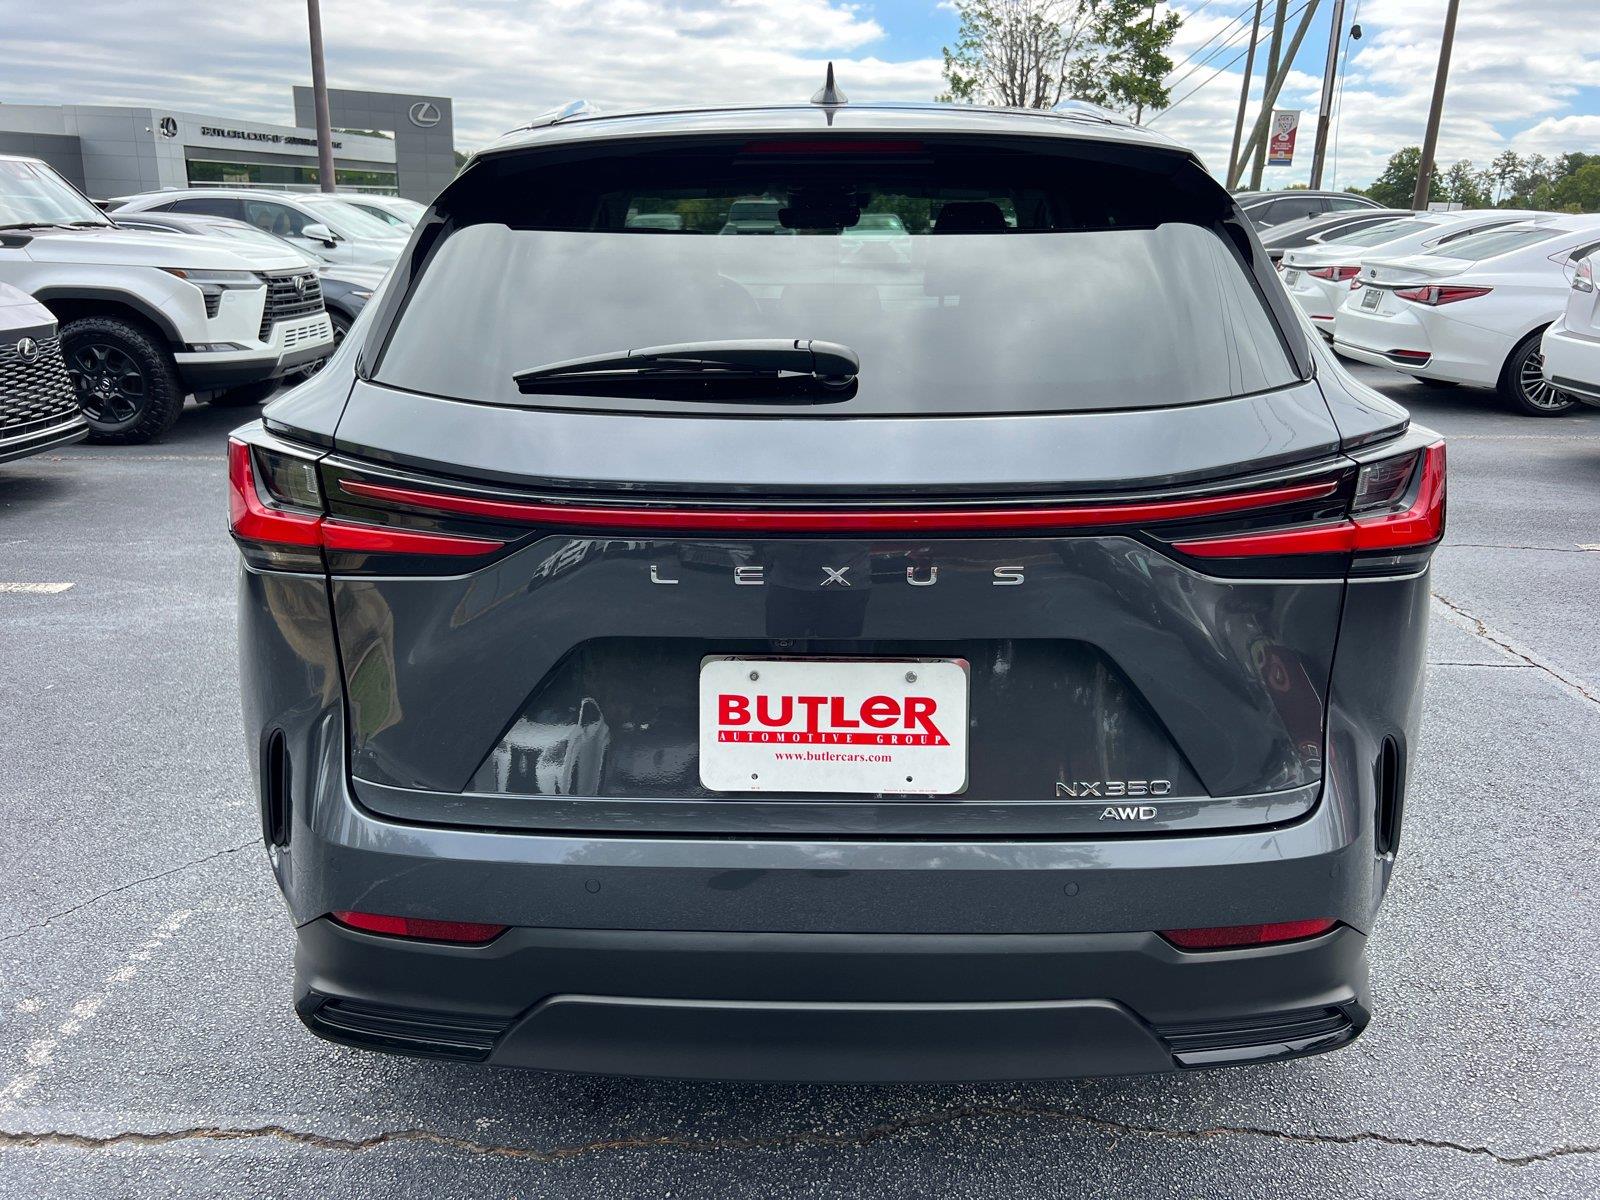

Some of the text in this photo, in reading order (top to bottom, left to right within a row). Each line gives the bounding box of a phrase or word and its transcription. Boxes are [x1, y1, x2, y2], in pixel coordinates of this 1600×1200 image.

[650, 565, 1024, 586] LEXUS
[719, 732, 942, 745] AUTOMOTIVE GROUP
[775, 750, 892, 763] www.butlercars.com
[1099, 806, 1157, 821] AWD
